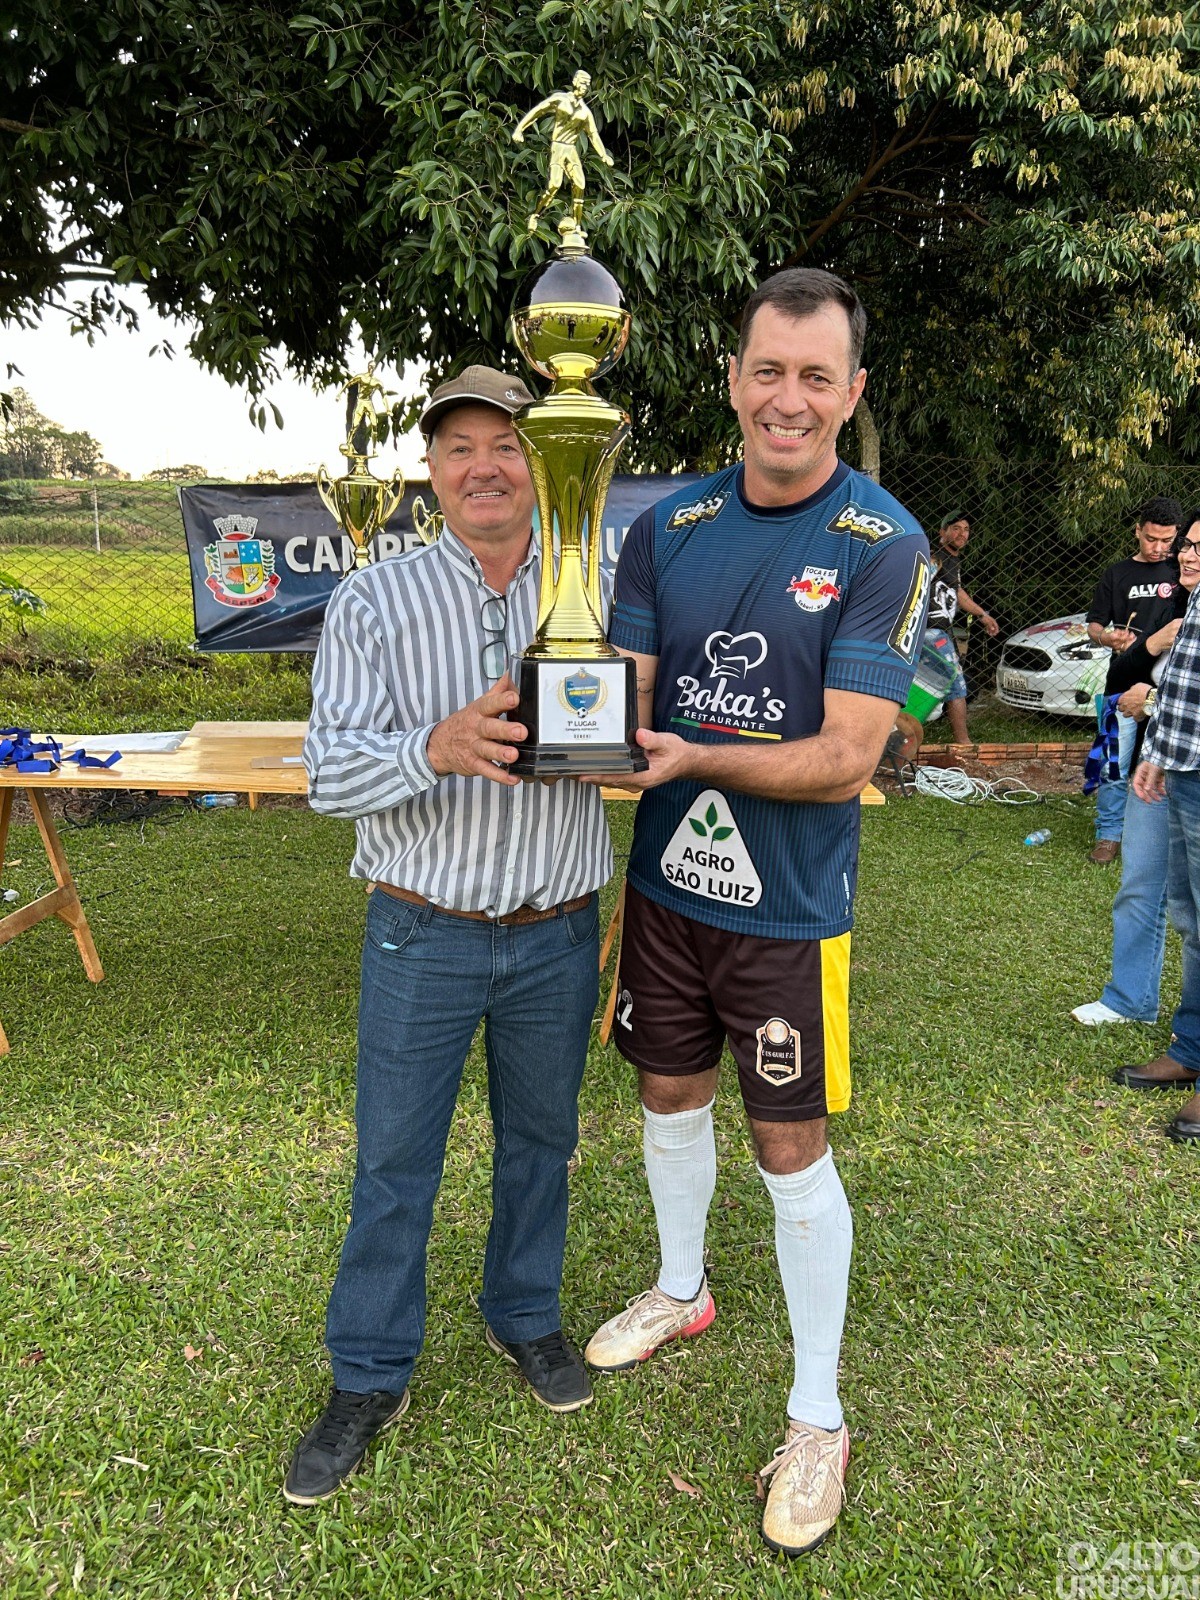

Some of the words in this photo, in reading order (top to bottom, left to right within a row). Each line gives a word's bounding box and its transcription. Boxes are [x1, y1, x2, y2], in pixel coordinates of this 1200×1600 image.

[838, 507, 894, 536] CHICO
[806, 567, 822, 575] TOCA
[900, 564, 930, 655] CHICO
[676, 675, 786, 722] Boka's
[683, 709, 766, 731] RESTAURANTE
[682, 846, 735, 873] AGRO
[665, 863, 700, 890] SÃO
[708, 878, 755, 904] LUIZ
